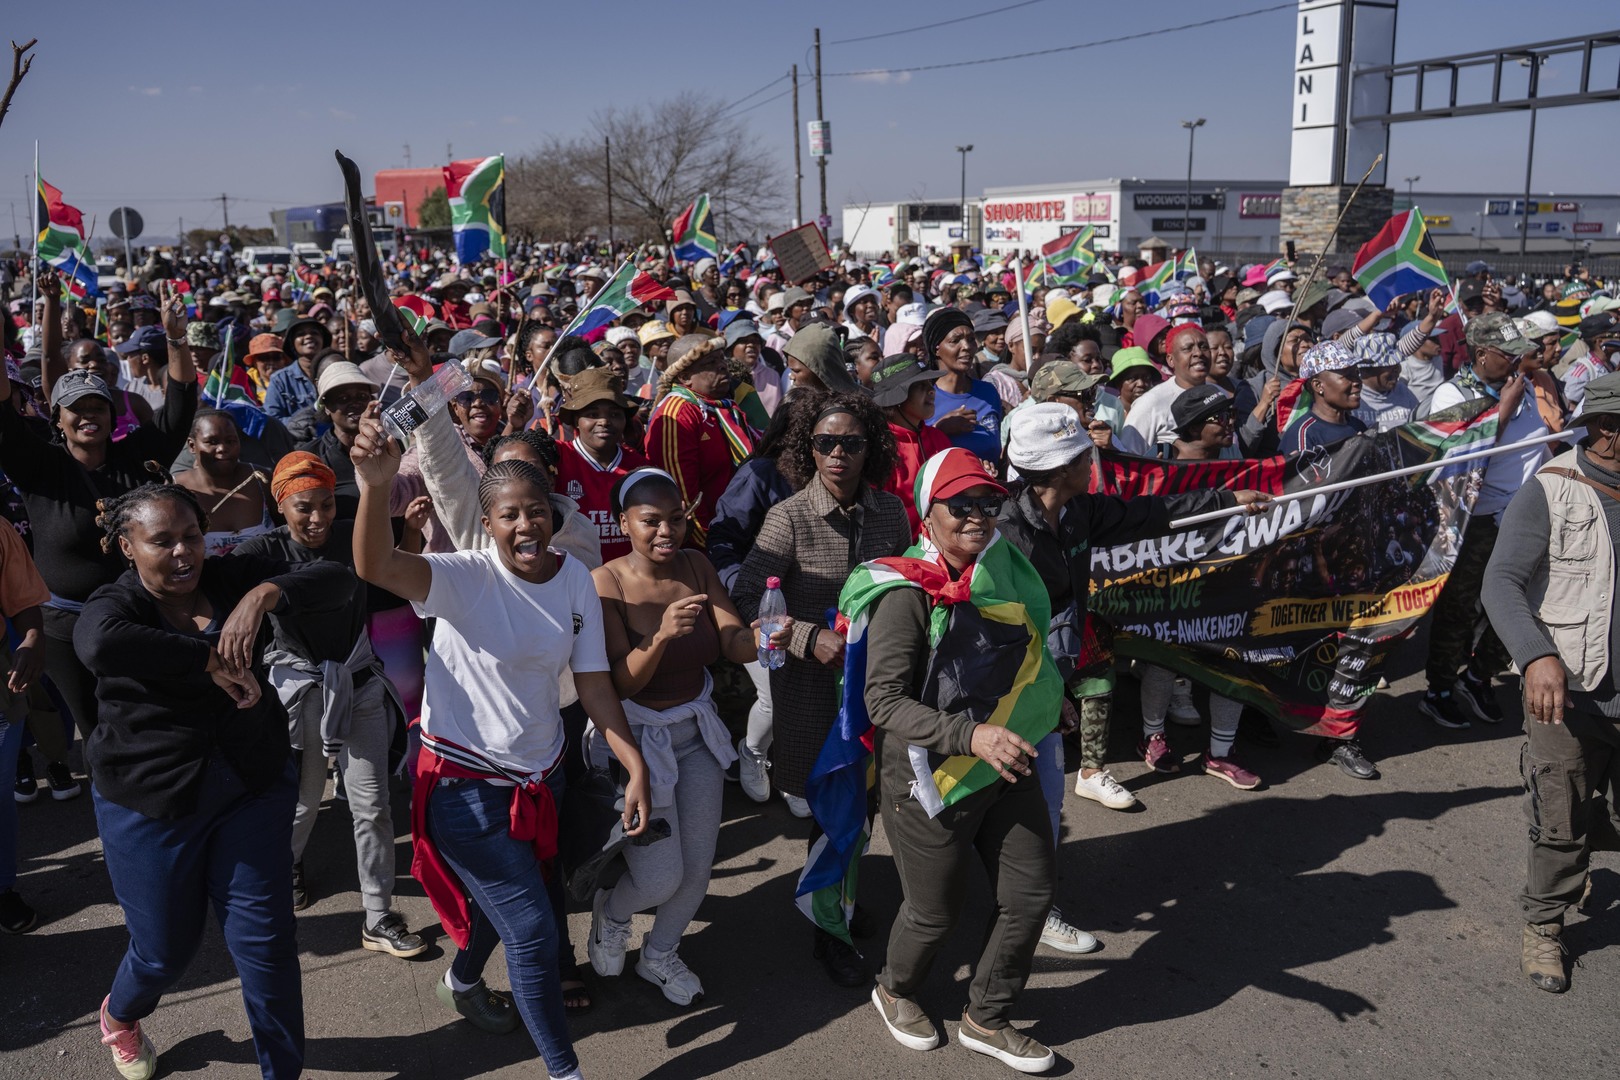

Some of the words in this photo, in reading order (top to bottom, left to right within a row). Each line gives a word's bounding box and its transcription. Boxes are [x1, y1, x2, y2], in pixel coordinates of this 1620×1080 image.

[1299, 0, 1314, 122] LANI
[1136, 195, 1203, 205] WOOLWORHS
[985, 201, 1064, 221] SHOPRITE
[393, 412, 412, 432] OWER
[588, 510, 616, 524] TEA
[1271, 602, 1328, 628] TOGETHER
[1331, 600, 1355, 622] WE
[1154, 611, 1248, 644] RE-AWAKENED!
